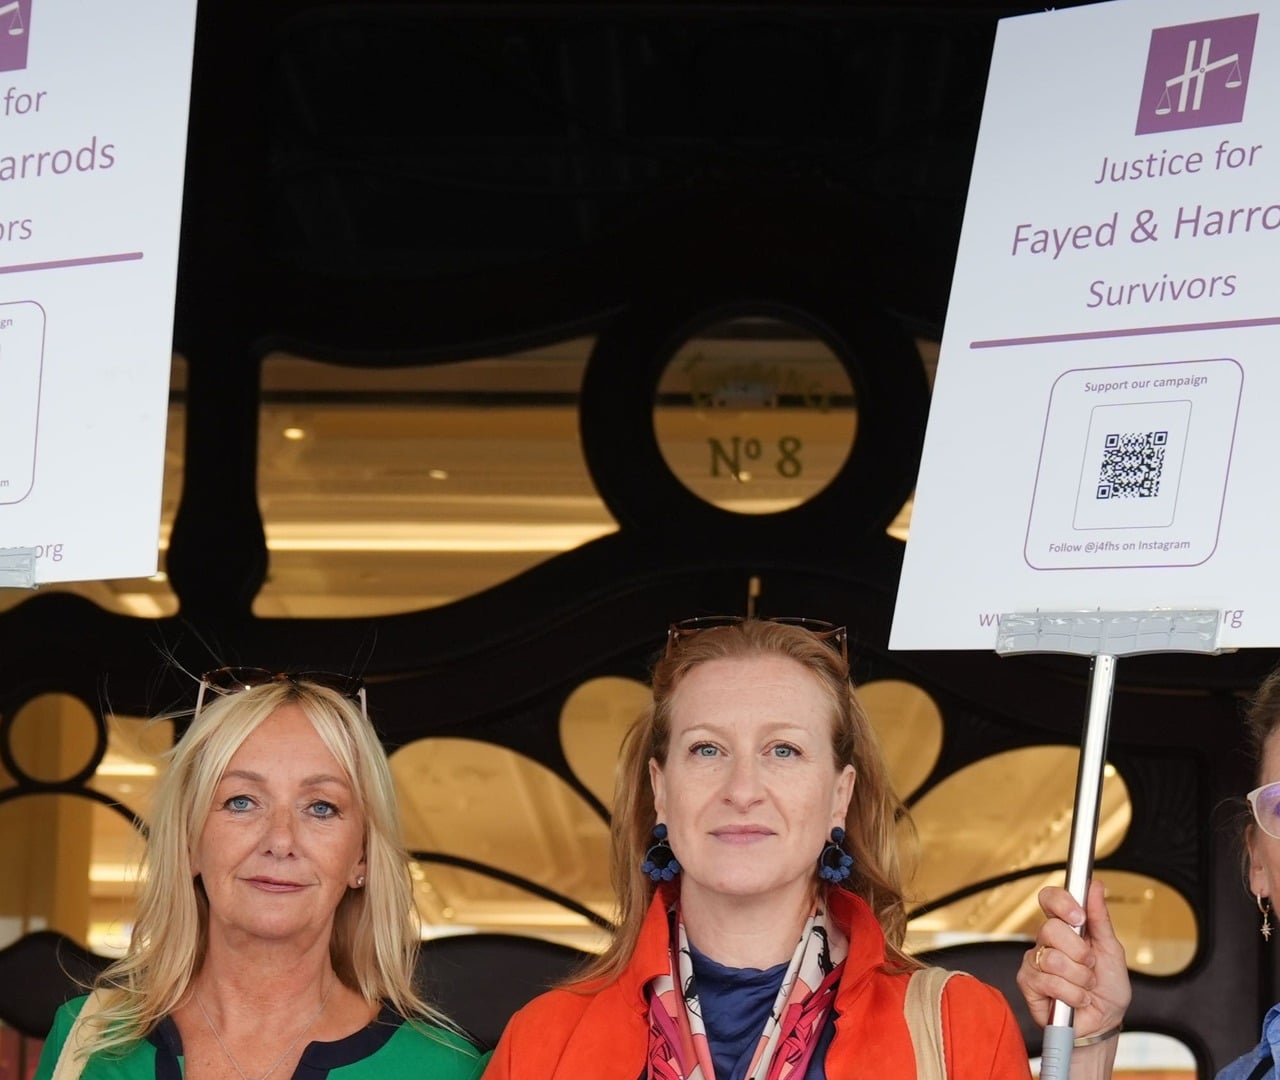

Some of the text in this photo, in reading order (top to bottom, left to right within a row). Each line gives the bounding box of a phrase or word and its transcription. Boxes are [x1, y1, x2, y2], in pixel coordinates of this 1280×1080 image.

[4, 87, 47, 117] for
[1095, 140, 1263, 184] Justice for
[1011, 212, 1119, 260] Fayed
[1130, 209, 1159, 243] &
[1087, 273, 1237, 309] Survivors
[1084, 375, 1207, 393] Support our campaign
[776, 436, 803, 479] 8
[1049, 542, 1081, 553] Follow
[1122, 542, 1136, 551] on
[1138, 541, 1190, 551] Instagram
